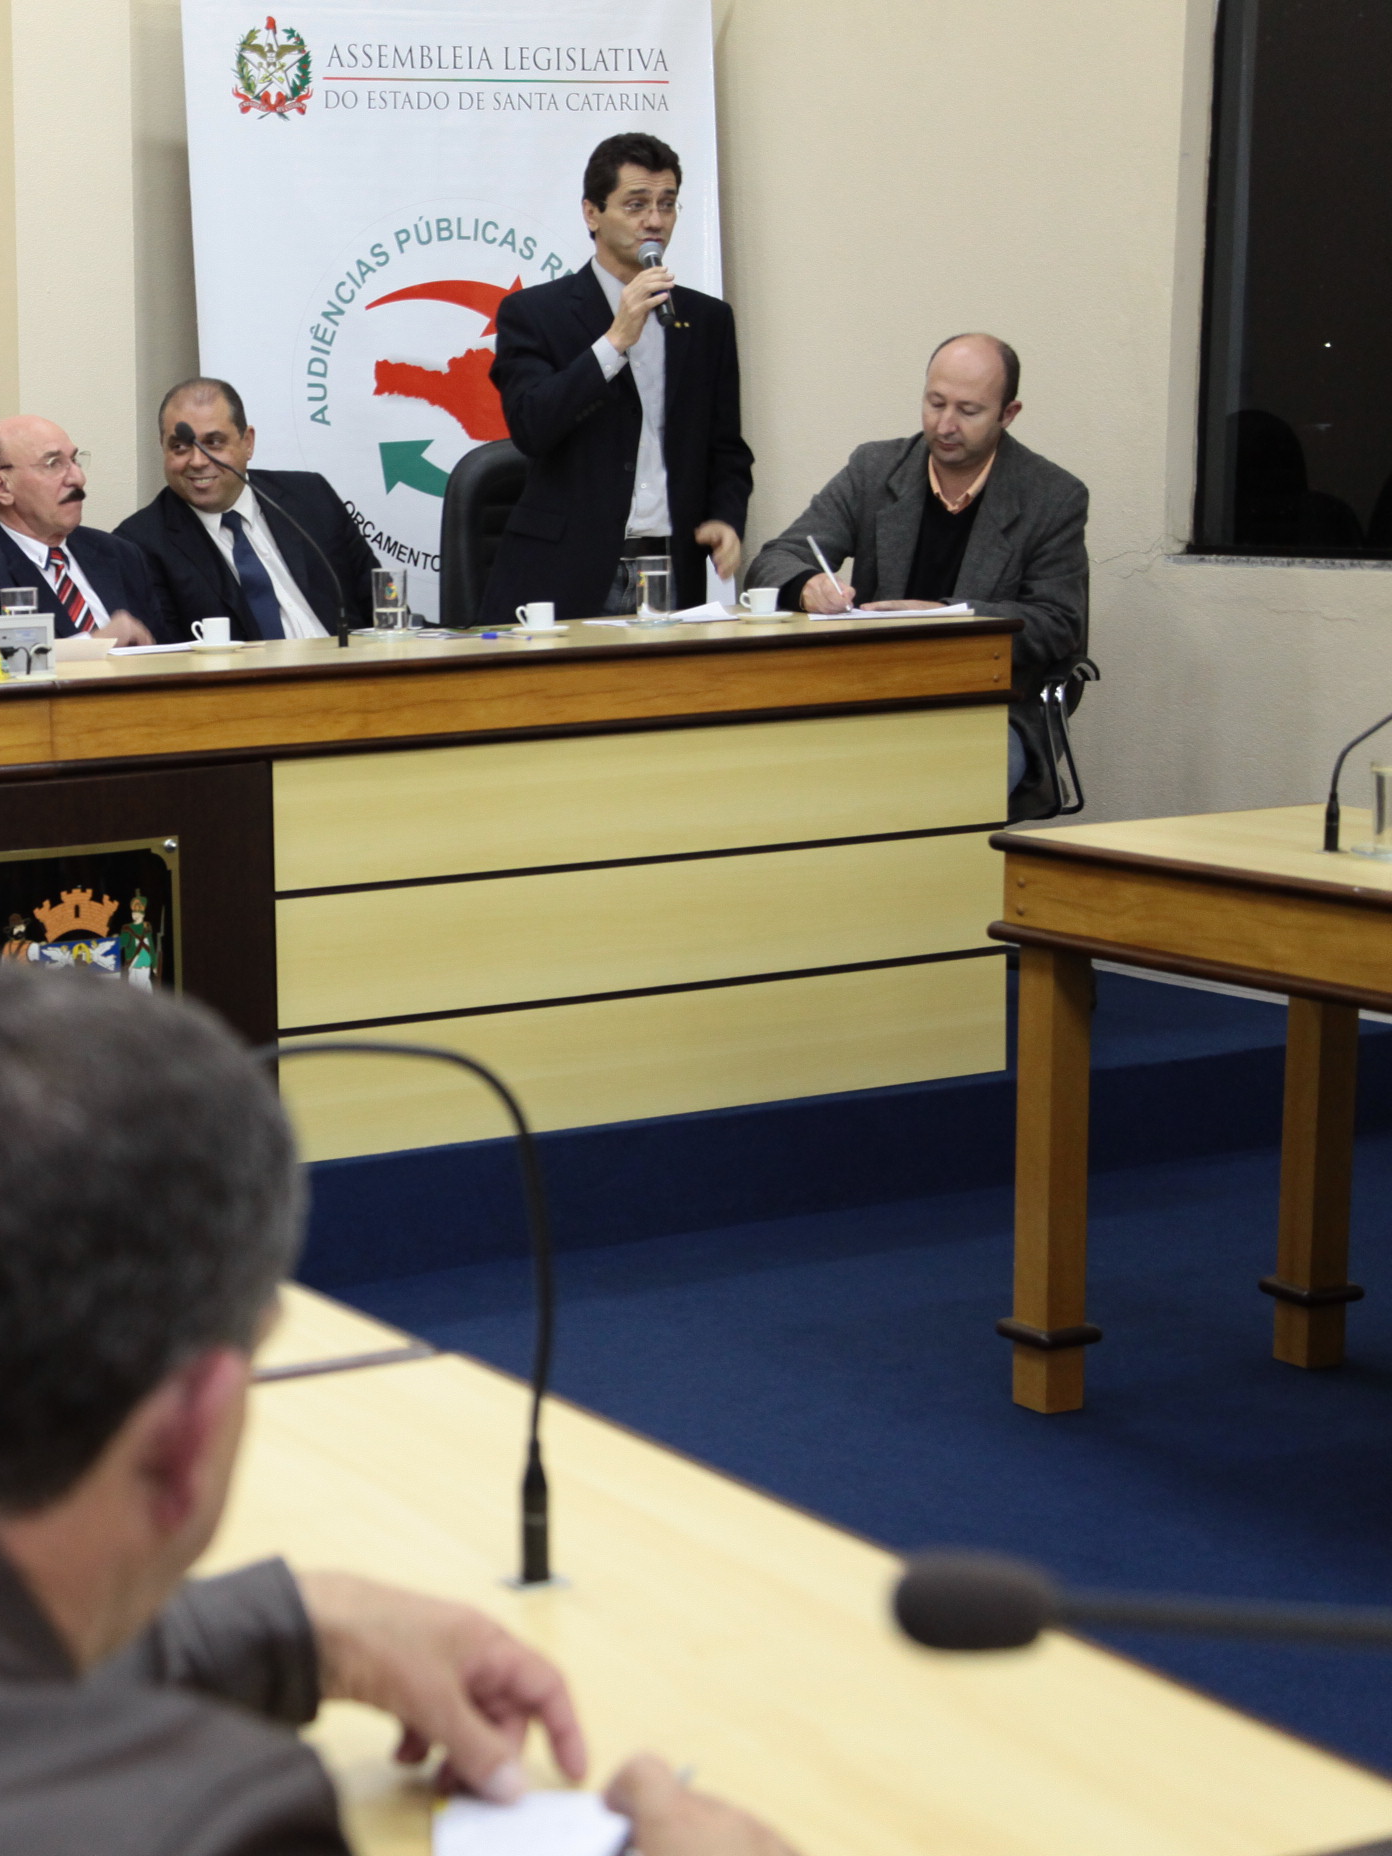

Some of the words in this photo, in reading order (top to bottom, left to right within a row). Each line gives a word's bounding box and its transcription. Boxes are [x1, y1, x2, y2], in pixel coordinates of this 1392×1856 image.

[326, 43, 494, 70] ASSEMBLEIA
[503, 46, 670, 72] LEGISLATIVA
[324, 90, 359, 110] DO
[367, 90, 450, 110] ESTADO
[458, 91, 486, 111] DE
[492, 91, 560, 112] SANTA
[565, 92, 670, 112] CATARINA
[306, 242, 391, 427] AUDIÊNCIAS
[393, 216, 539, 261] PÚBLICAS
